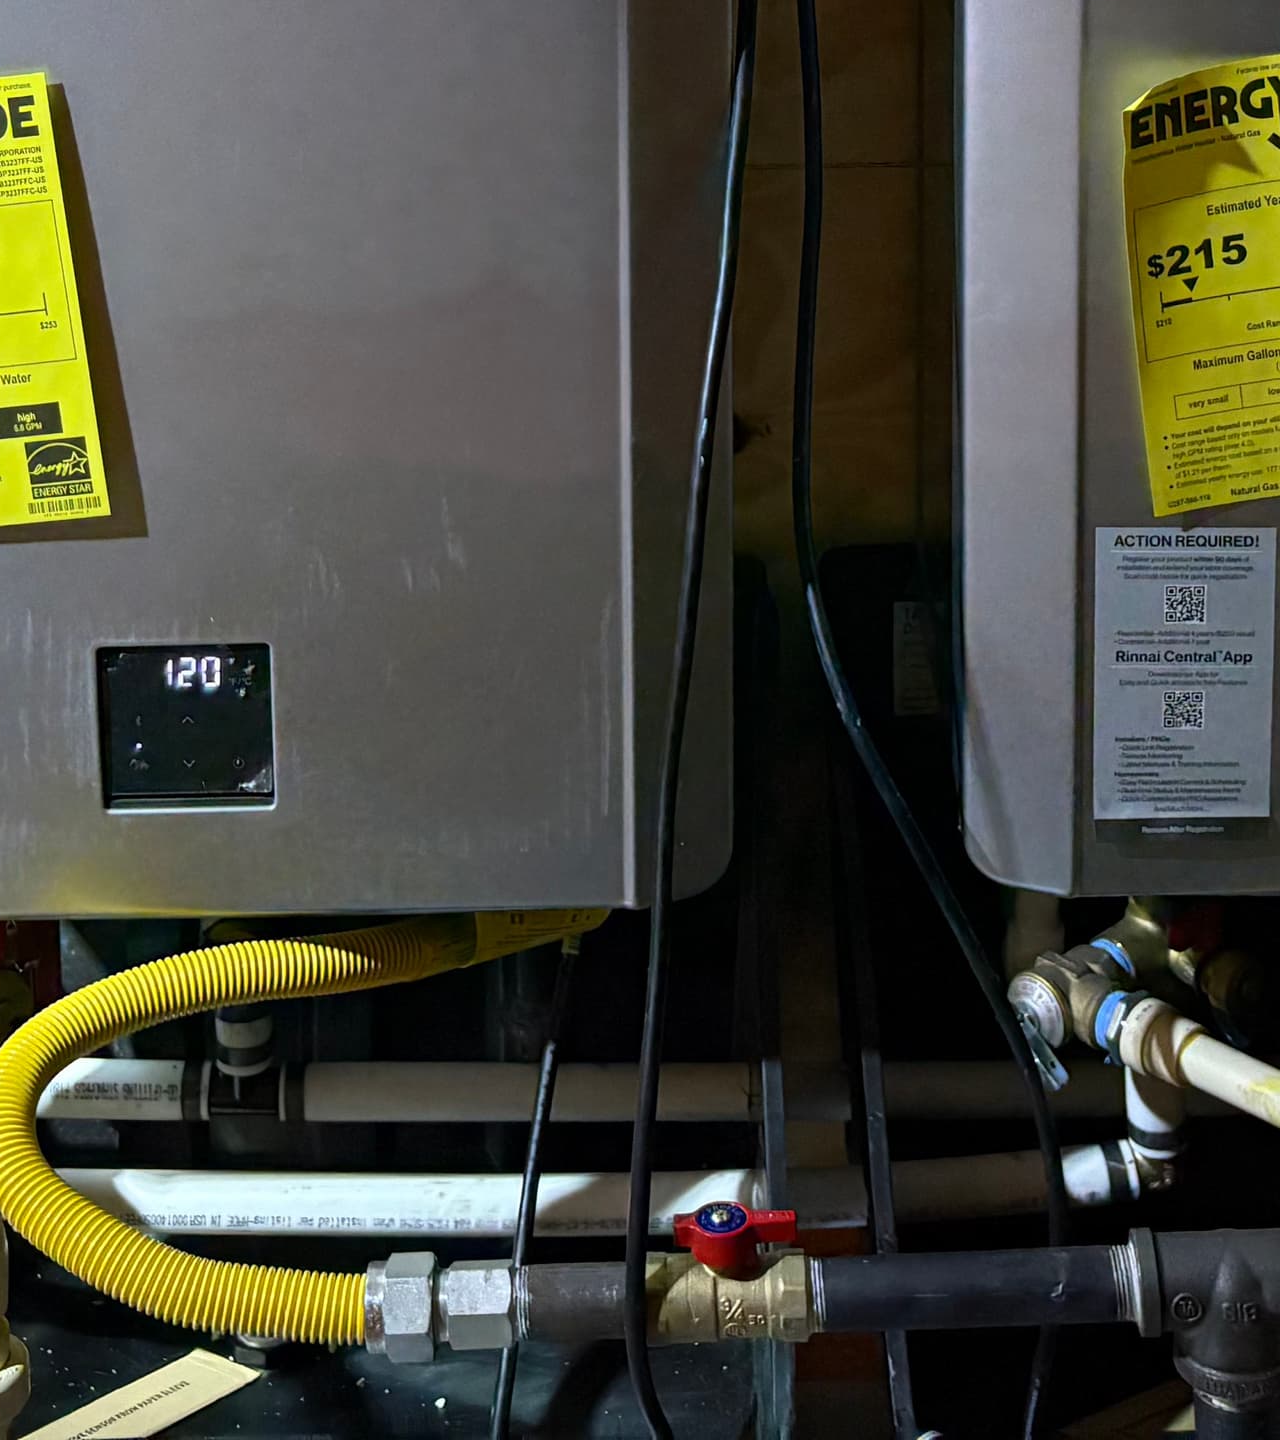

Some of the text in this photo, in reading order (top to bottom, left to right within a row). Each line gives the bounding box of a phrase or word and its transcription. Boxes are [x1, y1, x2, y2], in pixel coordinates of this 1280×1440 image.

[1207, 198, 1261, 216] Estimated
[1147, 233, 1248, 279] $215
[1247, 322, 1264, 331] Cost
[1193, 353, 1244, 371] Maximum
[3, 372, 32, 386] Water
[16, 411, 36, 423] high
[33, 482, 92, 497] ENERGY STAR
[1231, 484, 1258, 497] Natural
[1261, 481, 1279, 493] Gas
[1113, 534, 1259, 547] ACTION REQUIRED!
[1115, 650, 1160, 662] Rinnai
[1223, 650, 1252, 664] App
[164, 655, 221, 688] 120
